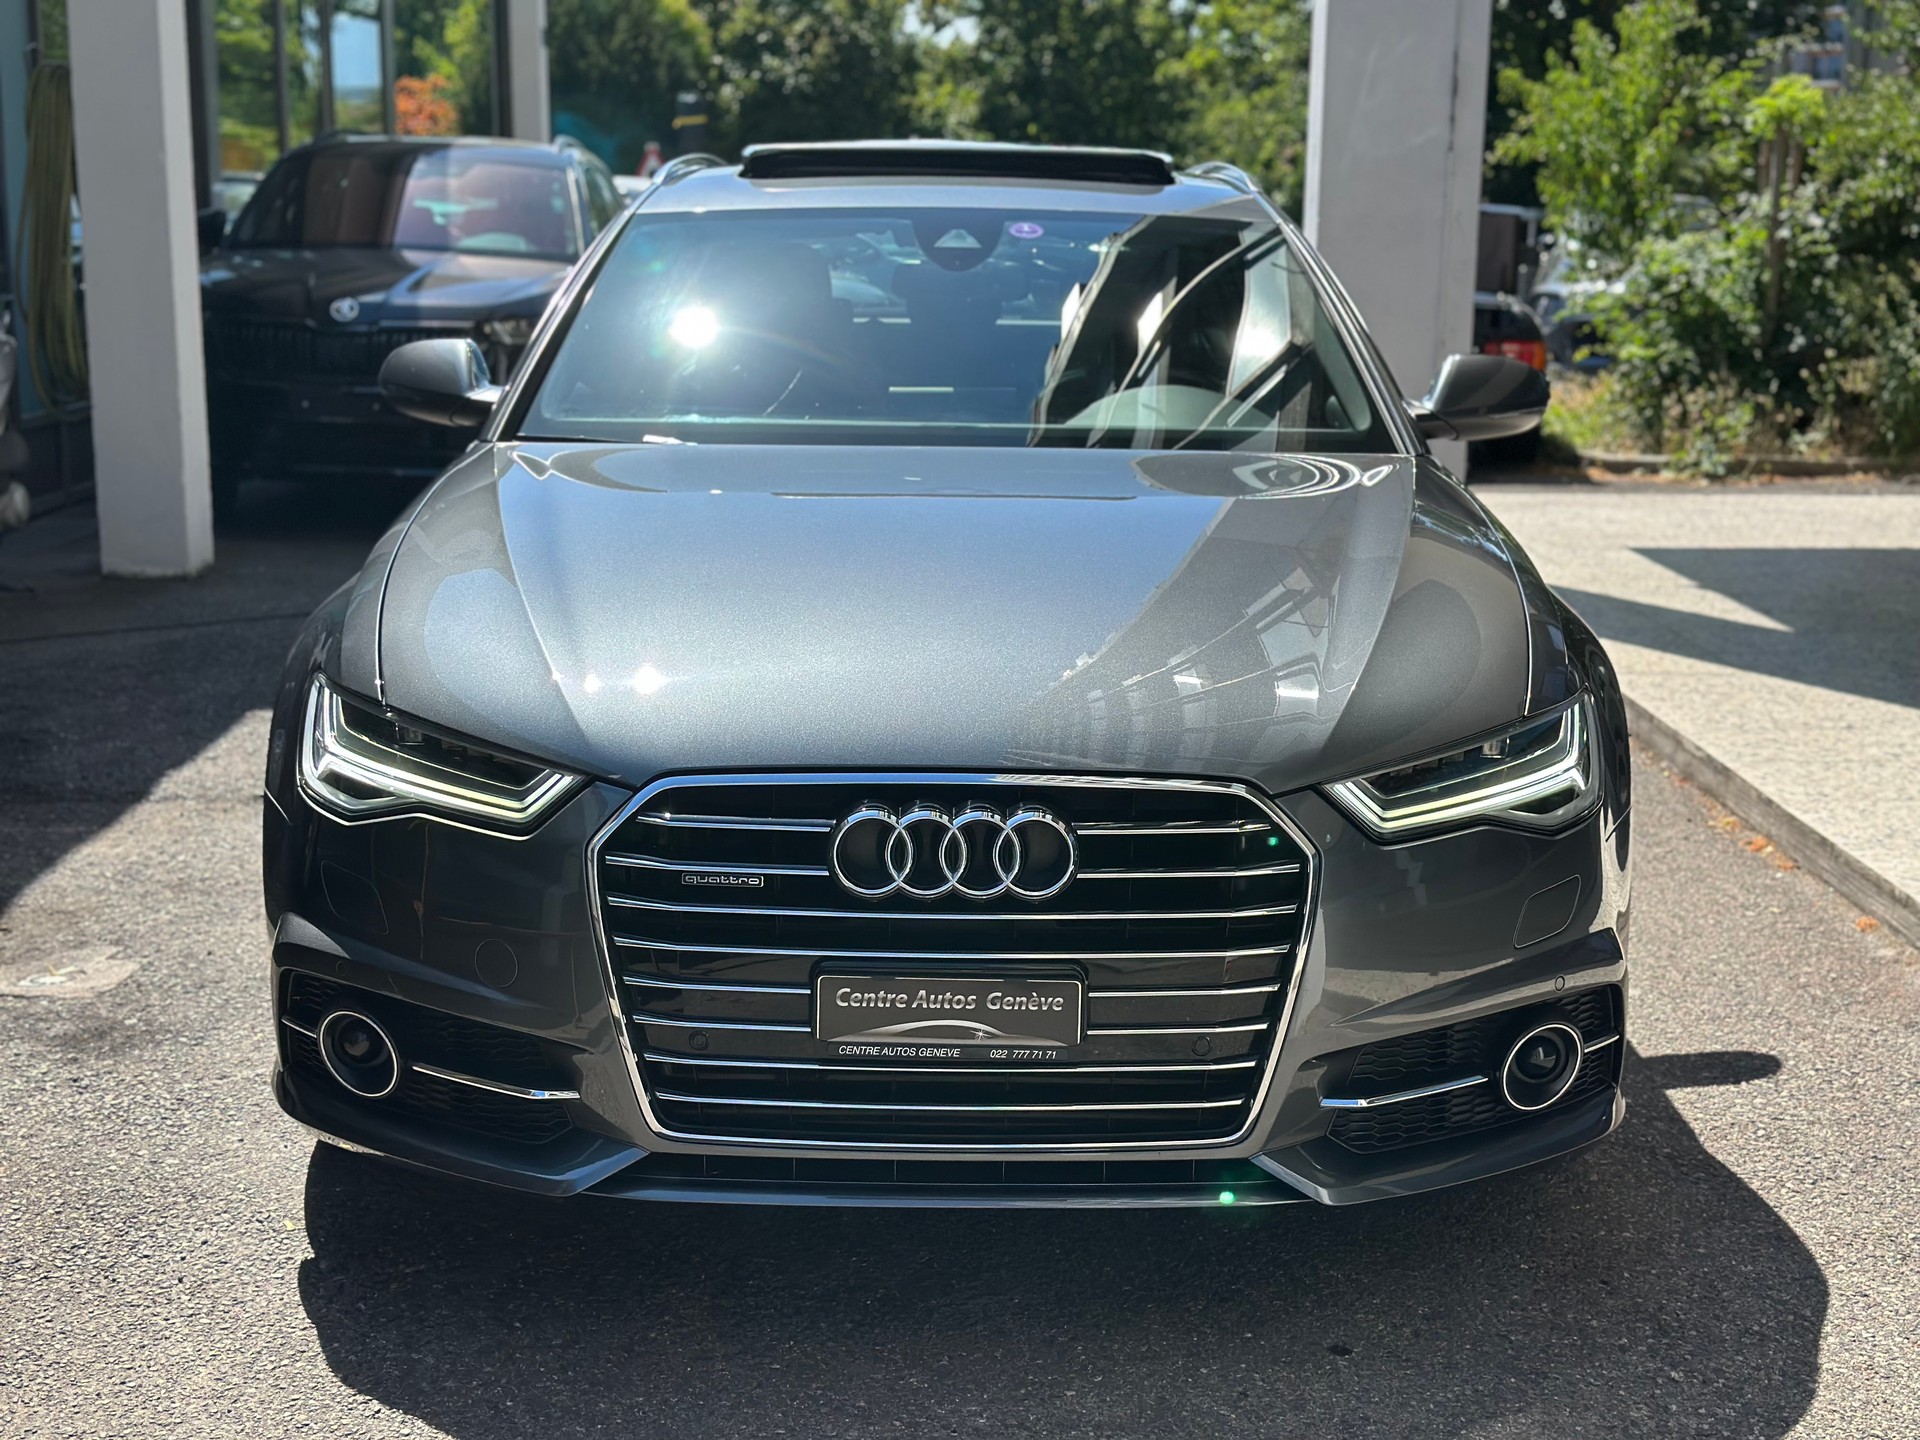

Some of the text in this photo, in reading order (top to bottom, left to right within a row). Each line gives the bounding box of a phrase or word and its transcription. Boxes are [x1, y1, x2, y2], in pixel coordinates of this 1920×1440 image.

[685, 875, 760, 884] quattro
[835, 987, 1064, 1011] Centre Autos Genève
[838, 1045, 961, 1057] CENTRE AUTOS GENEVE
[990, 1049, 1057, 1059] 022 777 71 71
